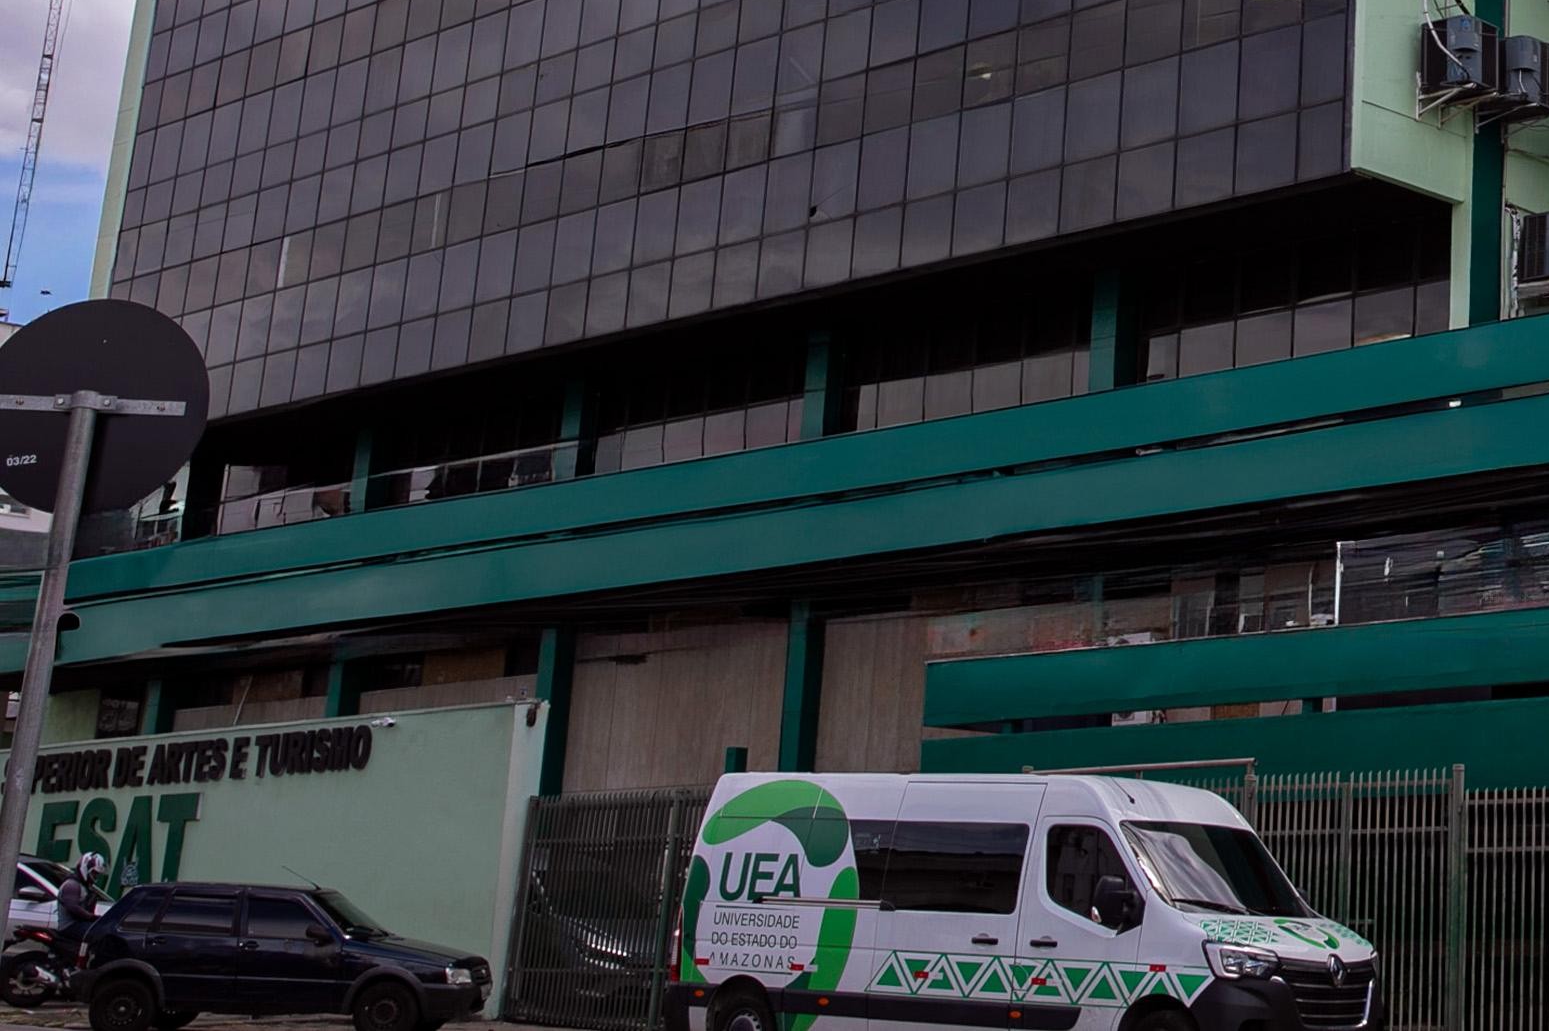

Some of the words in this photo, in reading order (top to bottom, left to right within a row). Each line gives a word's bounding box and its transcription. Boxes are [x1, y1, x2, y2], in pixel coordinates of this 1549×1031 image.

[6, 454, 37, 467] 03/22
[2, 748, 112, 794] PERIOR
[112, 745, 147, 788] DE
[146, 736, 228, 785] ARTES
[229, 736, 251, 780] E
[255, 725, 372, 778] TURISMO
[719, 852, 801, 901] UEA
[713, 911, 800, 929] UNIVERSIDADE
[711, 931, 728, 945] DO
[731, 932, 777, 948] ESTADO
[780, 935, 798, 949] DO
[710, 951, 795, 970] AMAZONAS
